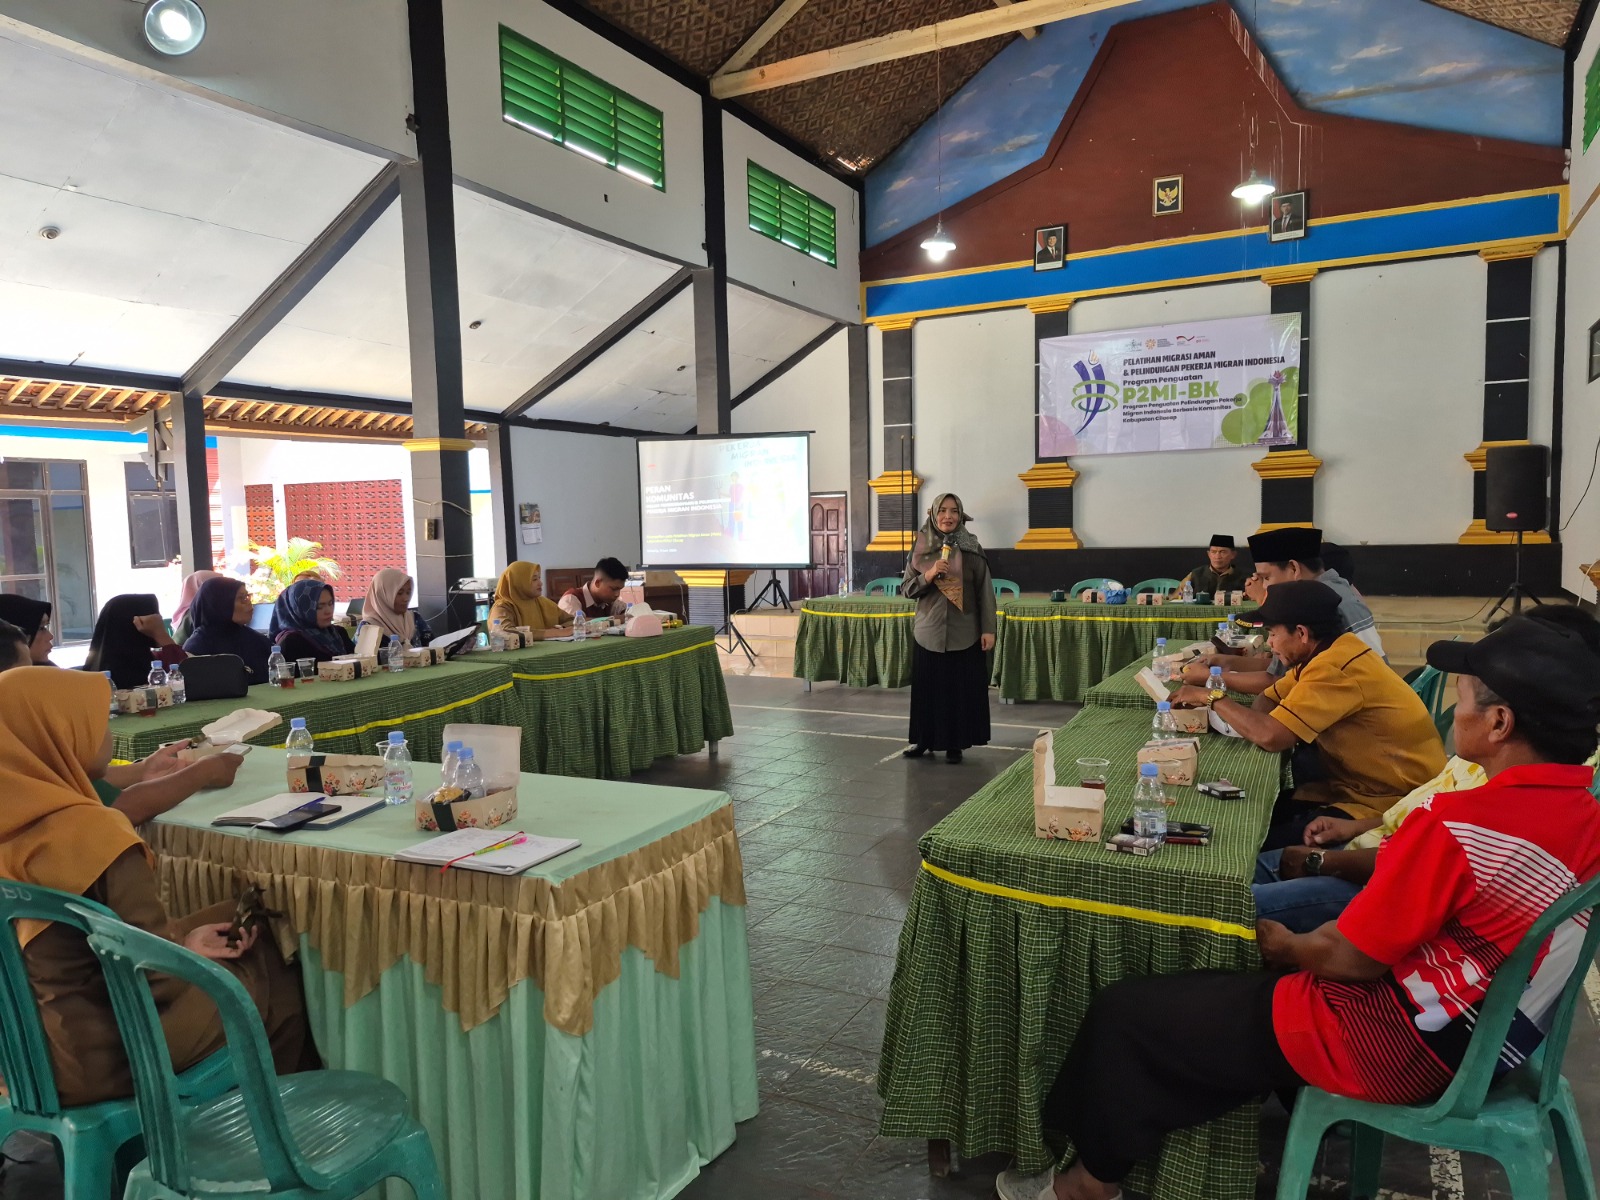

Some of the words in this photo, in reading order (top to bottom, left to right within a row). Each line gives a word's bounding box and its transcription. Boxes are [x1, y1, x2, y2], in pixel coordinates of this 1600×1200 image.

[1123, 355, 1161, 366] PELATIHAN
[1162, 353, 1192, 362] MIGRASI
[1193, 351, 1216, 360] AMAN
[1131, 365, 1180, 376] PELINDUNGAN
[1181, 362, 1212, 371] PEKERJA
[1214, 359, 1243, 369] MIGRAN
[1245, 356, 1286, 366] INDONESIA
[1123, 377, 1157, 386] Program
[1159, 374, 1203, 383] Penguatan
[1123, 381, 1219, 403] P2MI-BK
[1181, 398, 1218, 406] Pelindungan
[1144, 407, 1172, 415] Indonesia
[646, 485, 671, 494] PERAN
[646, 492, 695, 503] KOMUNITAS
